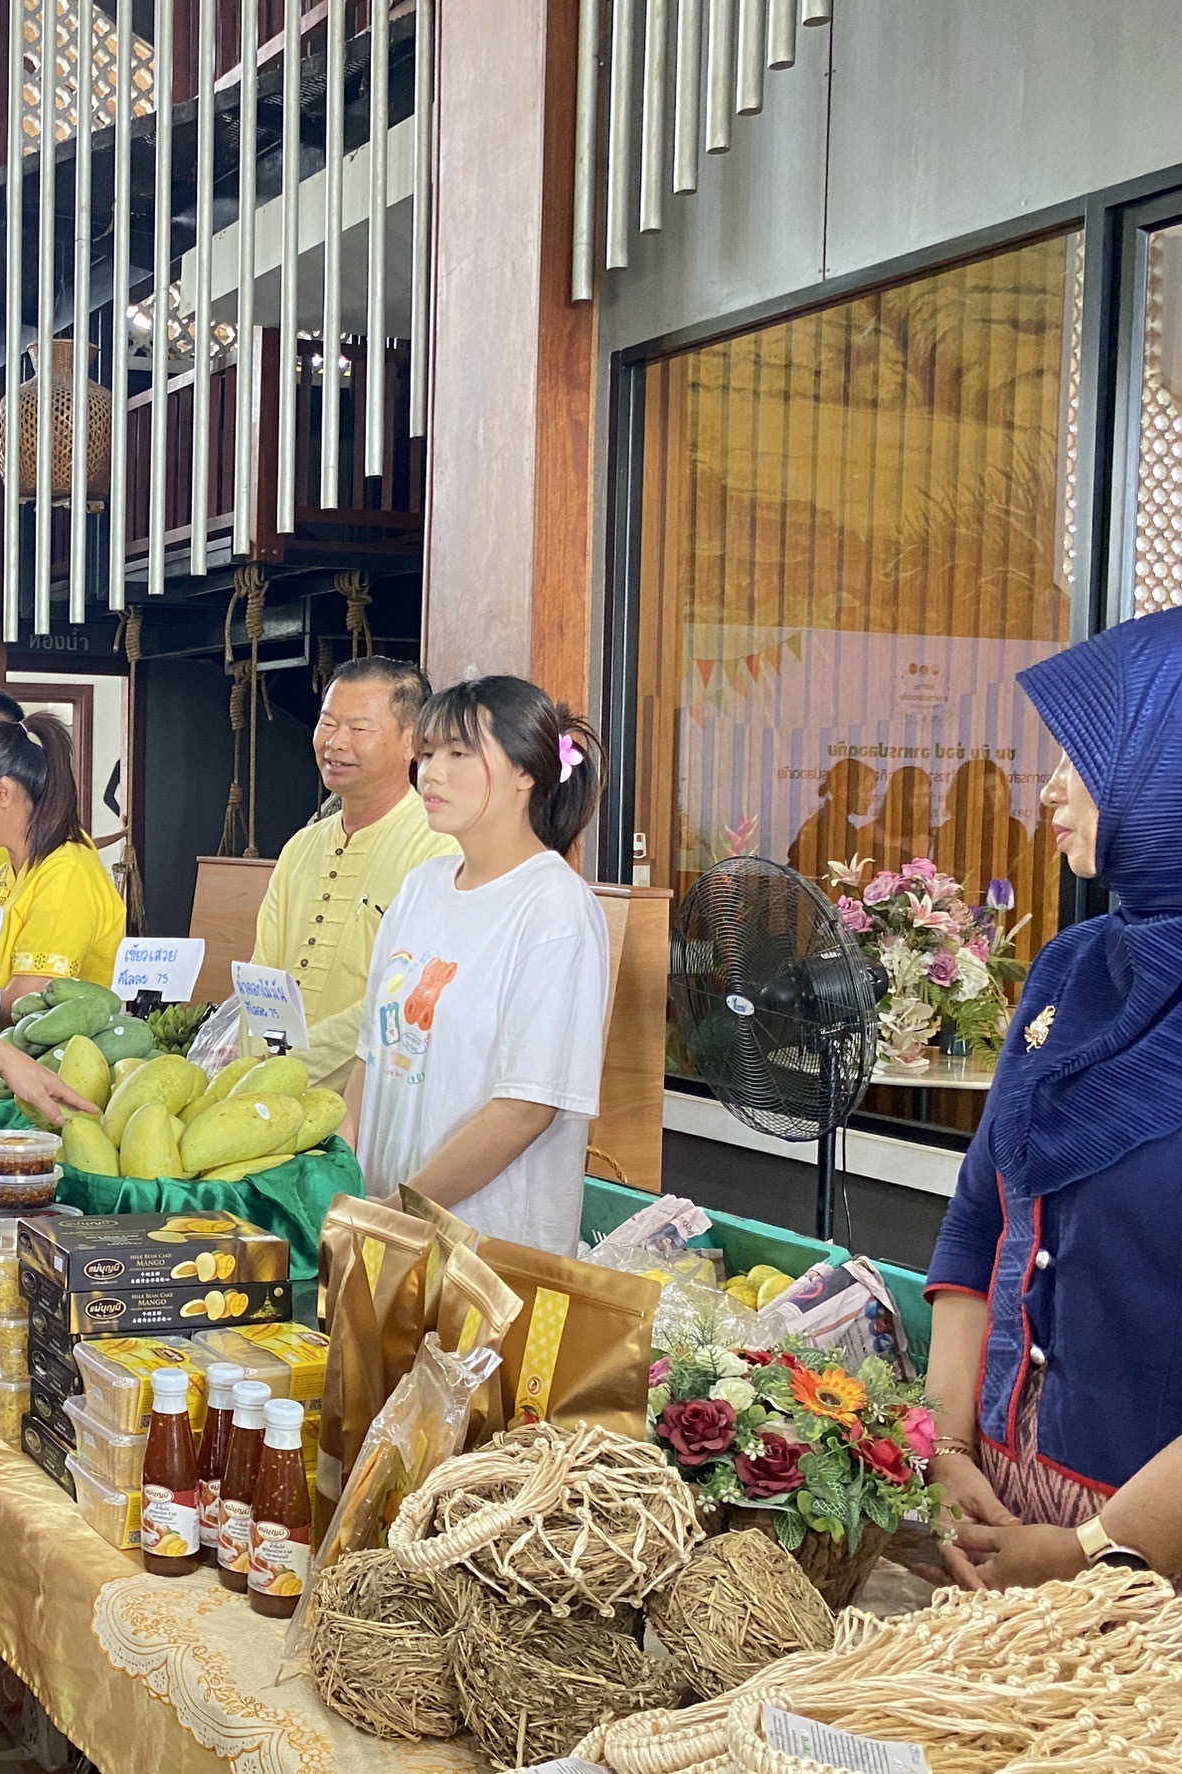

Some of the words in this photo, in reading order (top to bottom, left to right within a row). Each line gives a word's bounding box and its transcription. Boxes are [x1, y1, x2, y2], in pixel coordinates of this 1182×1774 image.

[29, 627, 89, 651] หองน้ำ
[157, 973, 169, 984] 75
[136, 1259, 166, 1267] MANGO
[137, 1298, 167, 1306] MANGO
